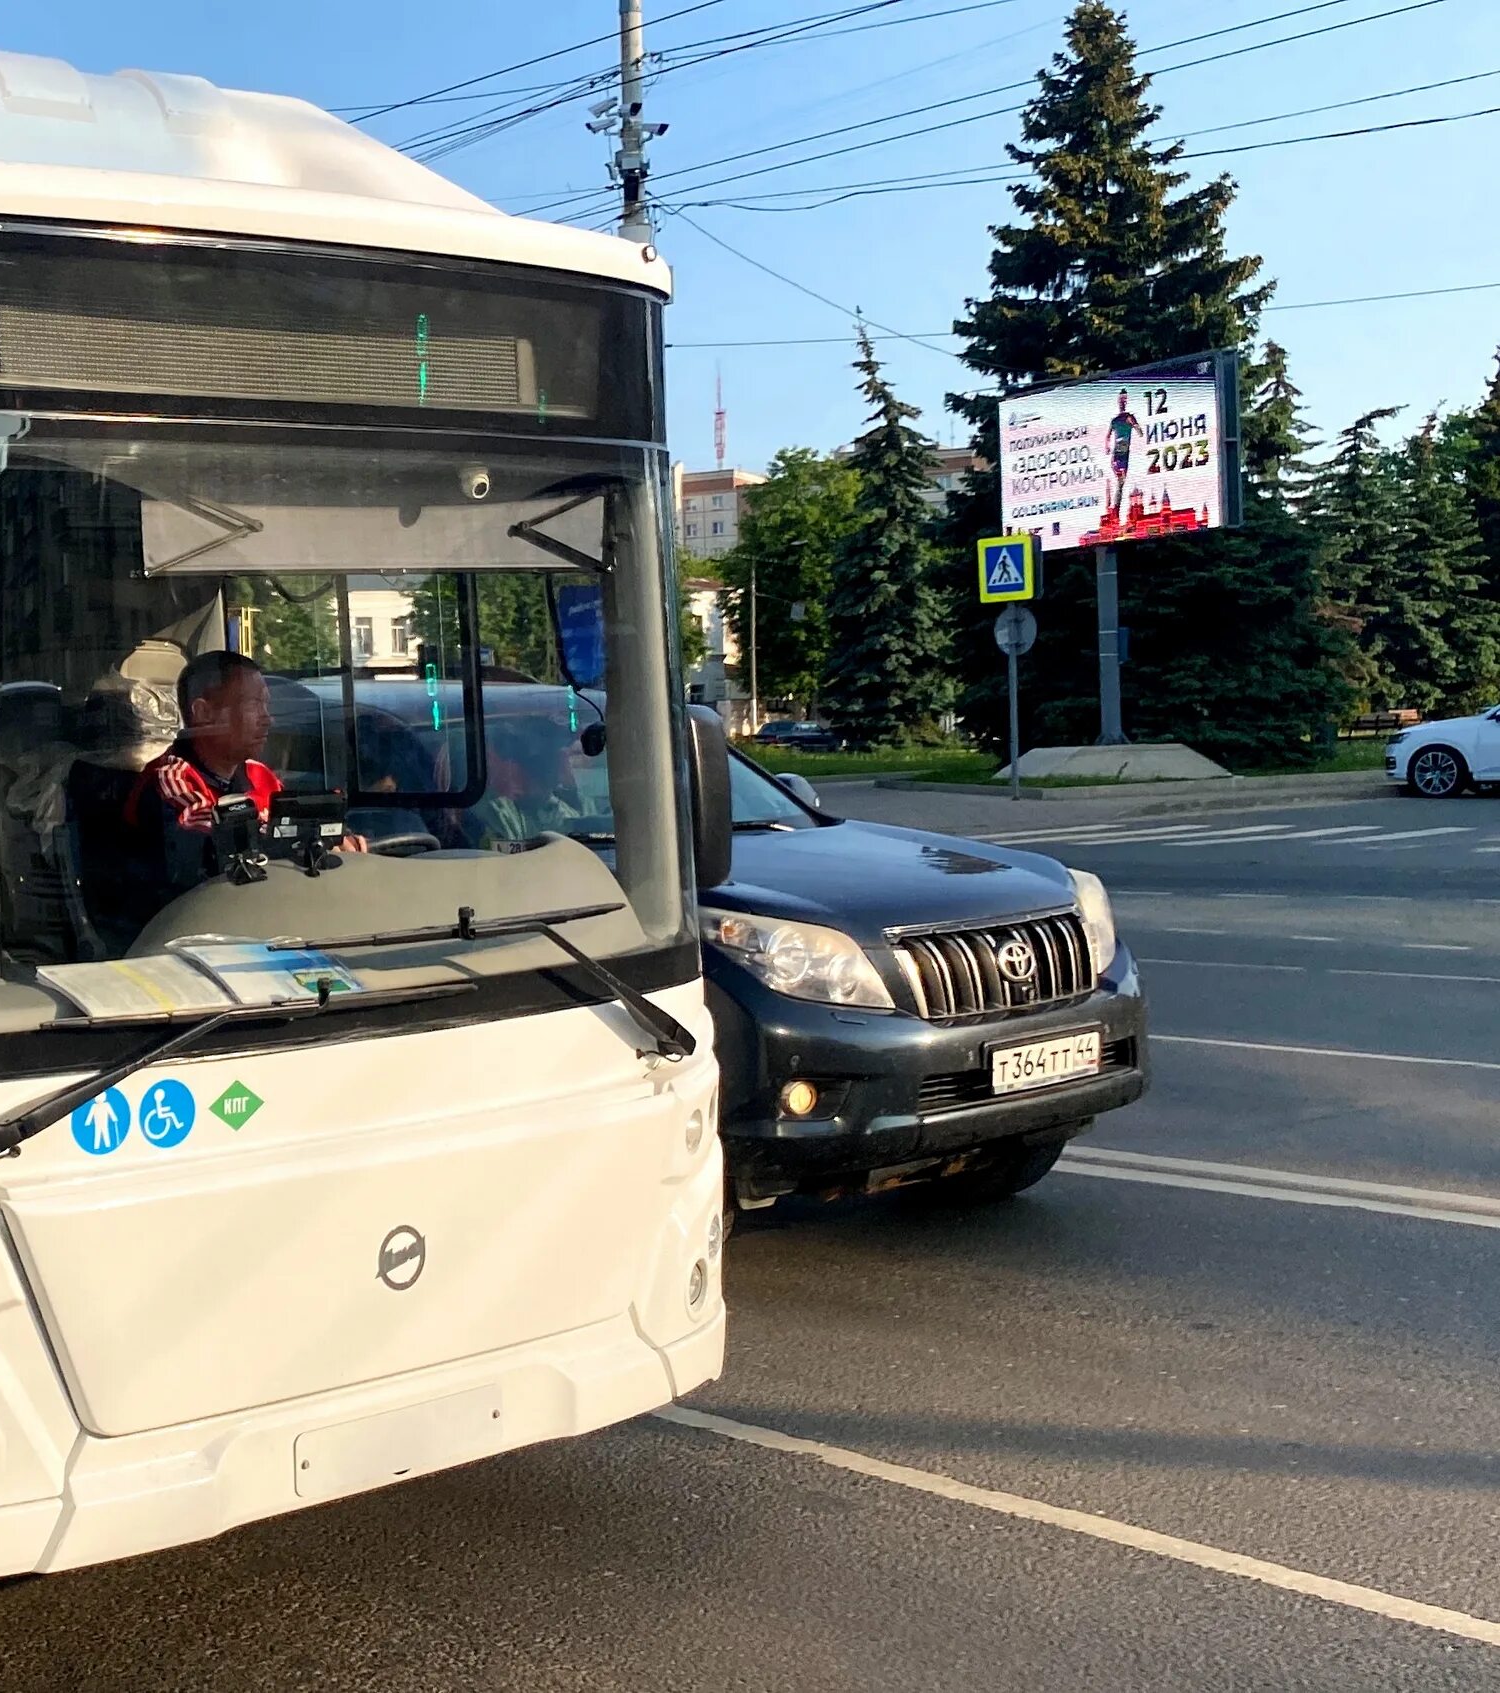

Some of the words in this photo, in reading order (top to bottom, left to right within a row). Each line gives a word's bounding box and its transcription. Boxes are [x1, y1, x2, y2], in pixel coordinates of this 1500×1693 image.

[1143, 388, 1168, 417] 12
[1146, 413, 1207, 445] ИЮНЯ
[1145, 439, 1210, 476] 2023
[223, 1096, 250, 1115] КПГ
